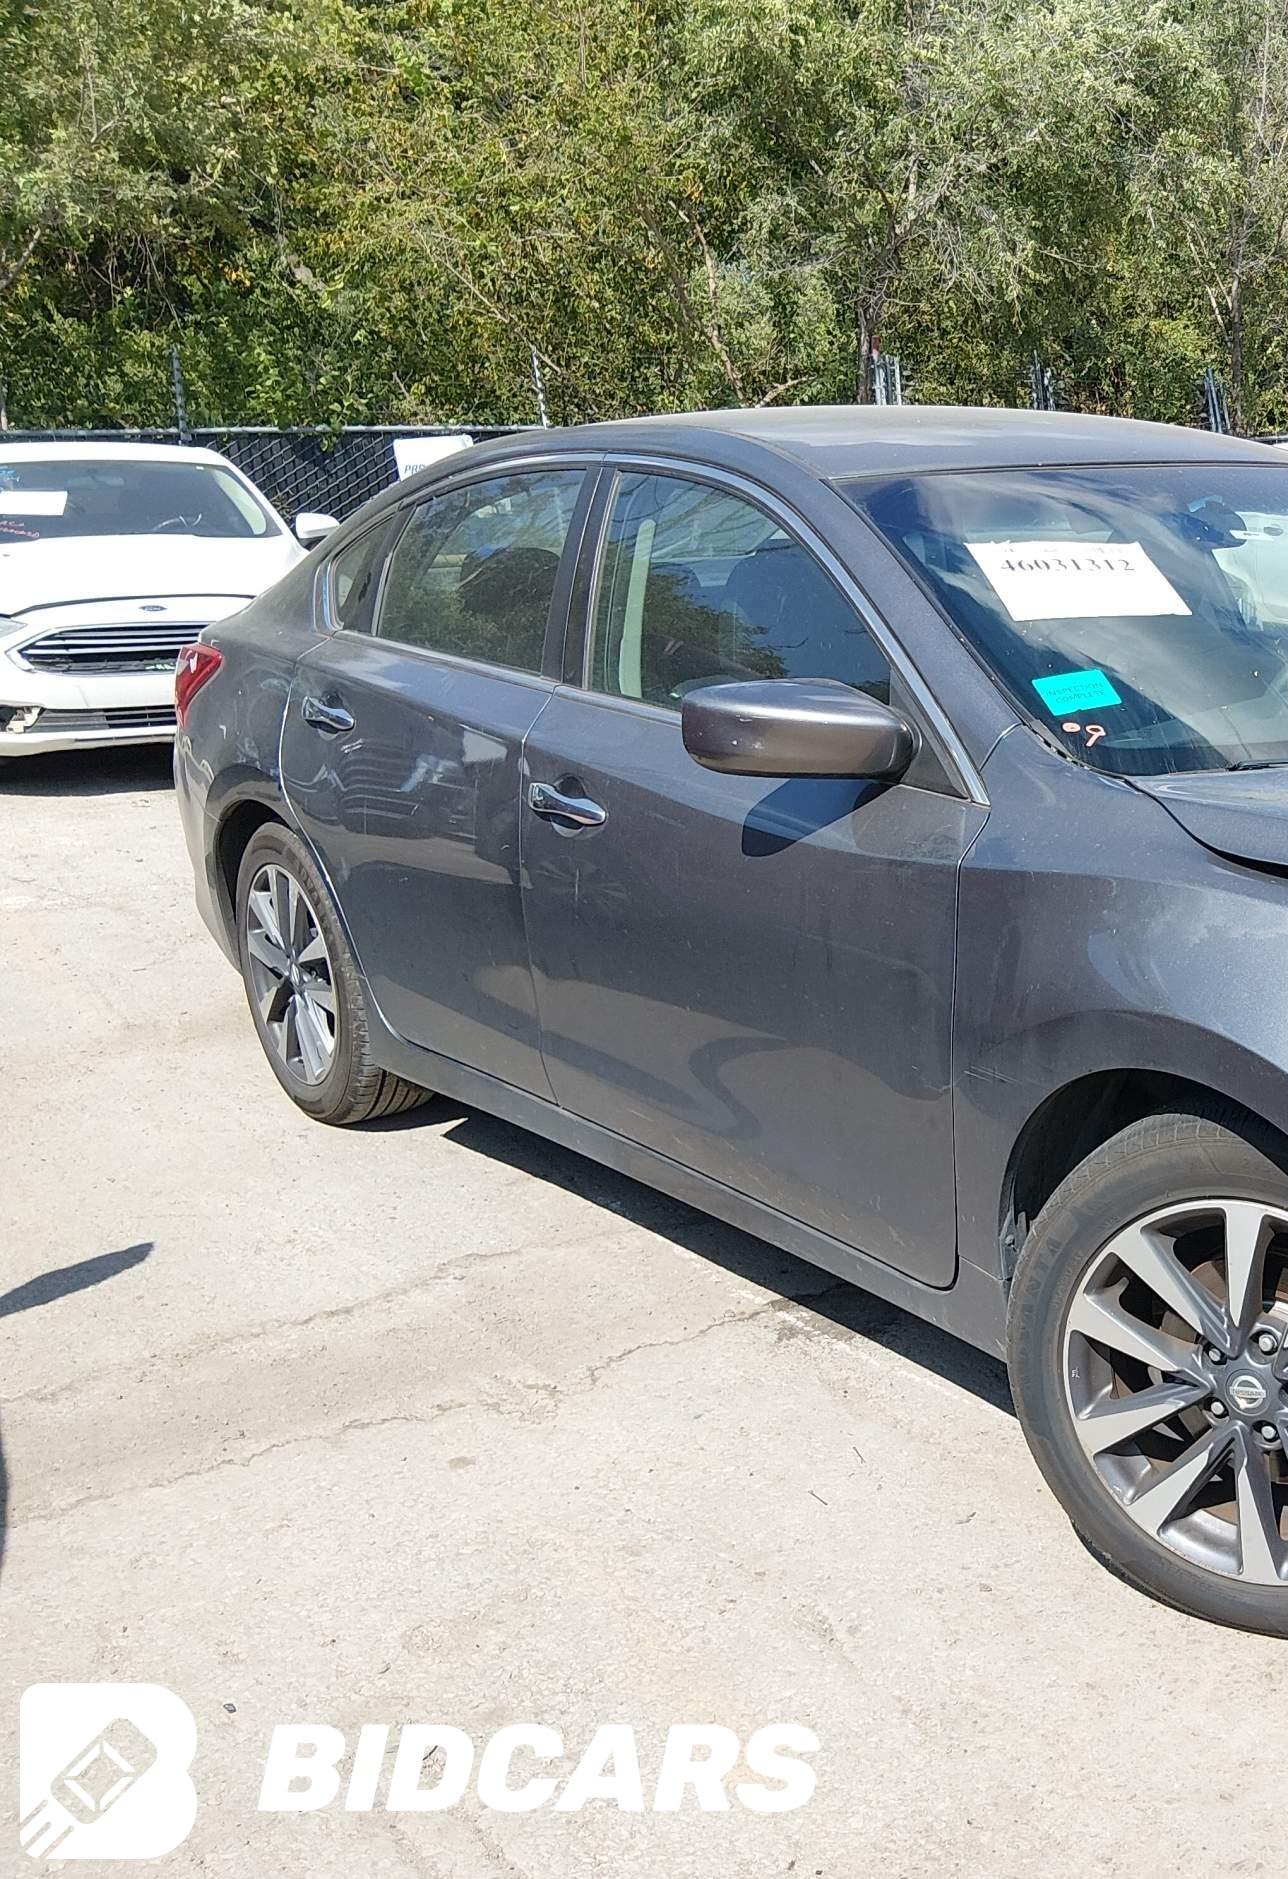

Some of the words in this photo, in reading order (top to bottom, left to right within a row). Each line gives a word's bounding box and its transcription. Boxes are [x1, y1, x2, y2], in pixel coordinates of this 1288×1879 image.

[1000, 558, 1136, 572] 46031312
[1046, 682, 1105, 697] INSPECTION
[1056, 689, 1105, 703] COMPLETE
